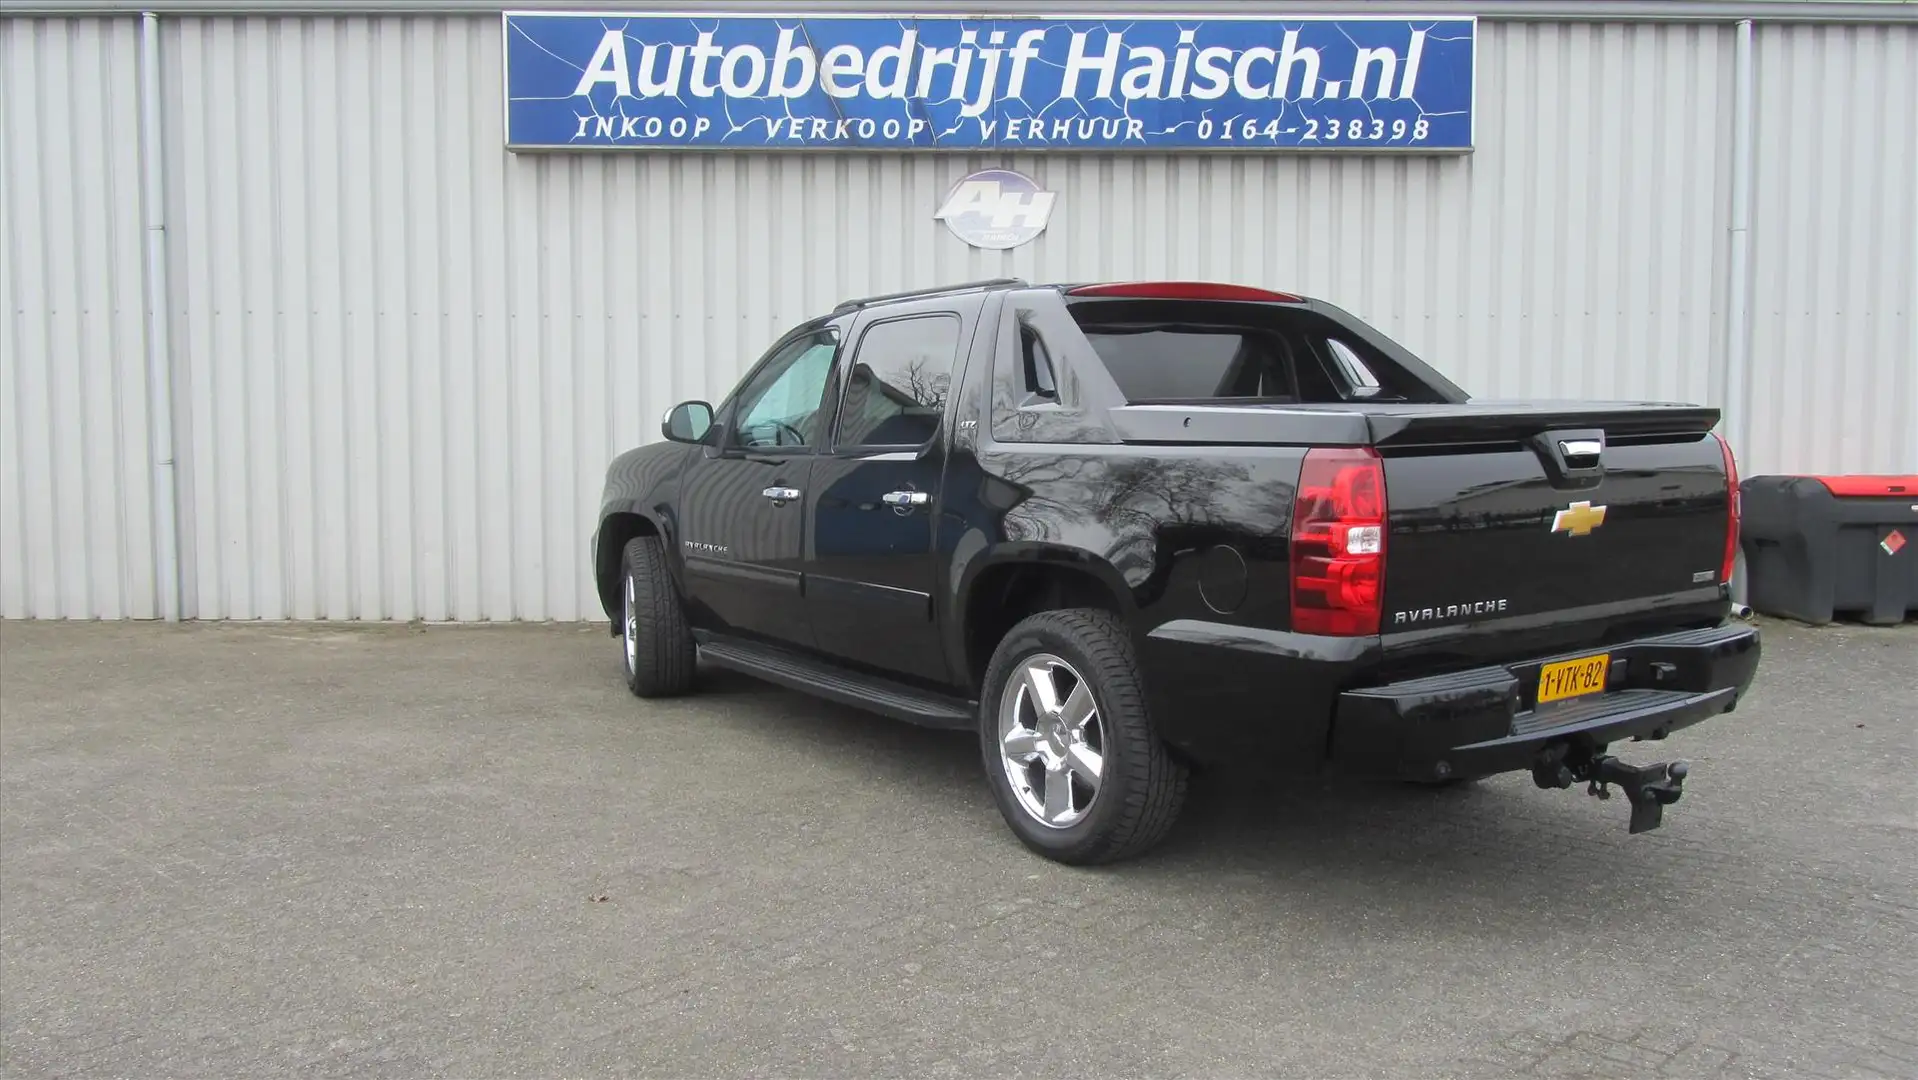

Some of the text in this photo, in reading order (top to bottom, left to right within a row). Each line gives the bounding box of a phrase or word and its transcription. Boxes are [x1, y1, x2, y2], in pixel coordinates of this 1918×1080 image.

[574, 28, 1425, 117] Autobedrijf Haisch.nl
[576, 116, 710, 137] INKOOP
[766, 118, 924, 139] VERKOOP
[980, 119, 1144, 140] VERHUUR
[1197, 119, 1429, 139] 0164-238398
[934, 180, 1056, 228] AH
[684, 541, 728, 553] AVALANCHE
[1394, 599, 1507, 624] AVALANCHE
[1545, 661, 1602, 696] 1-VTK-82
